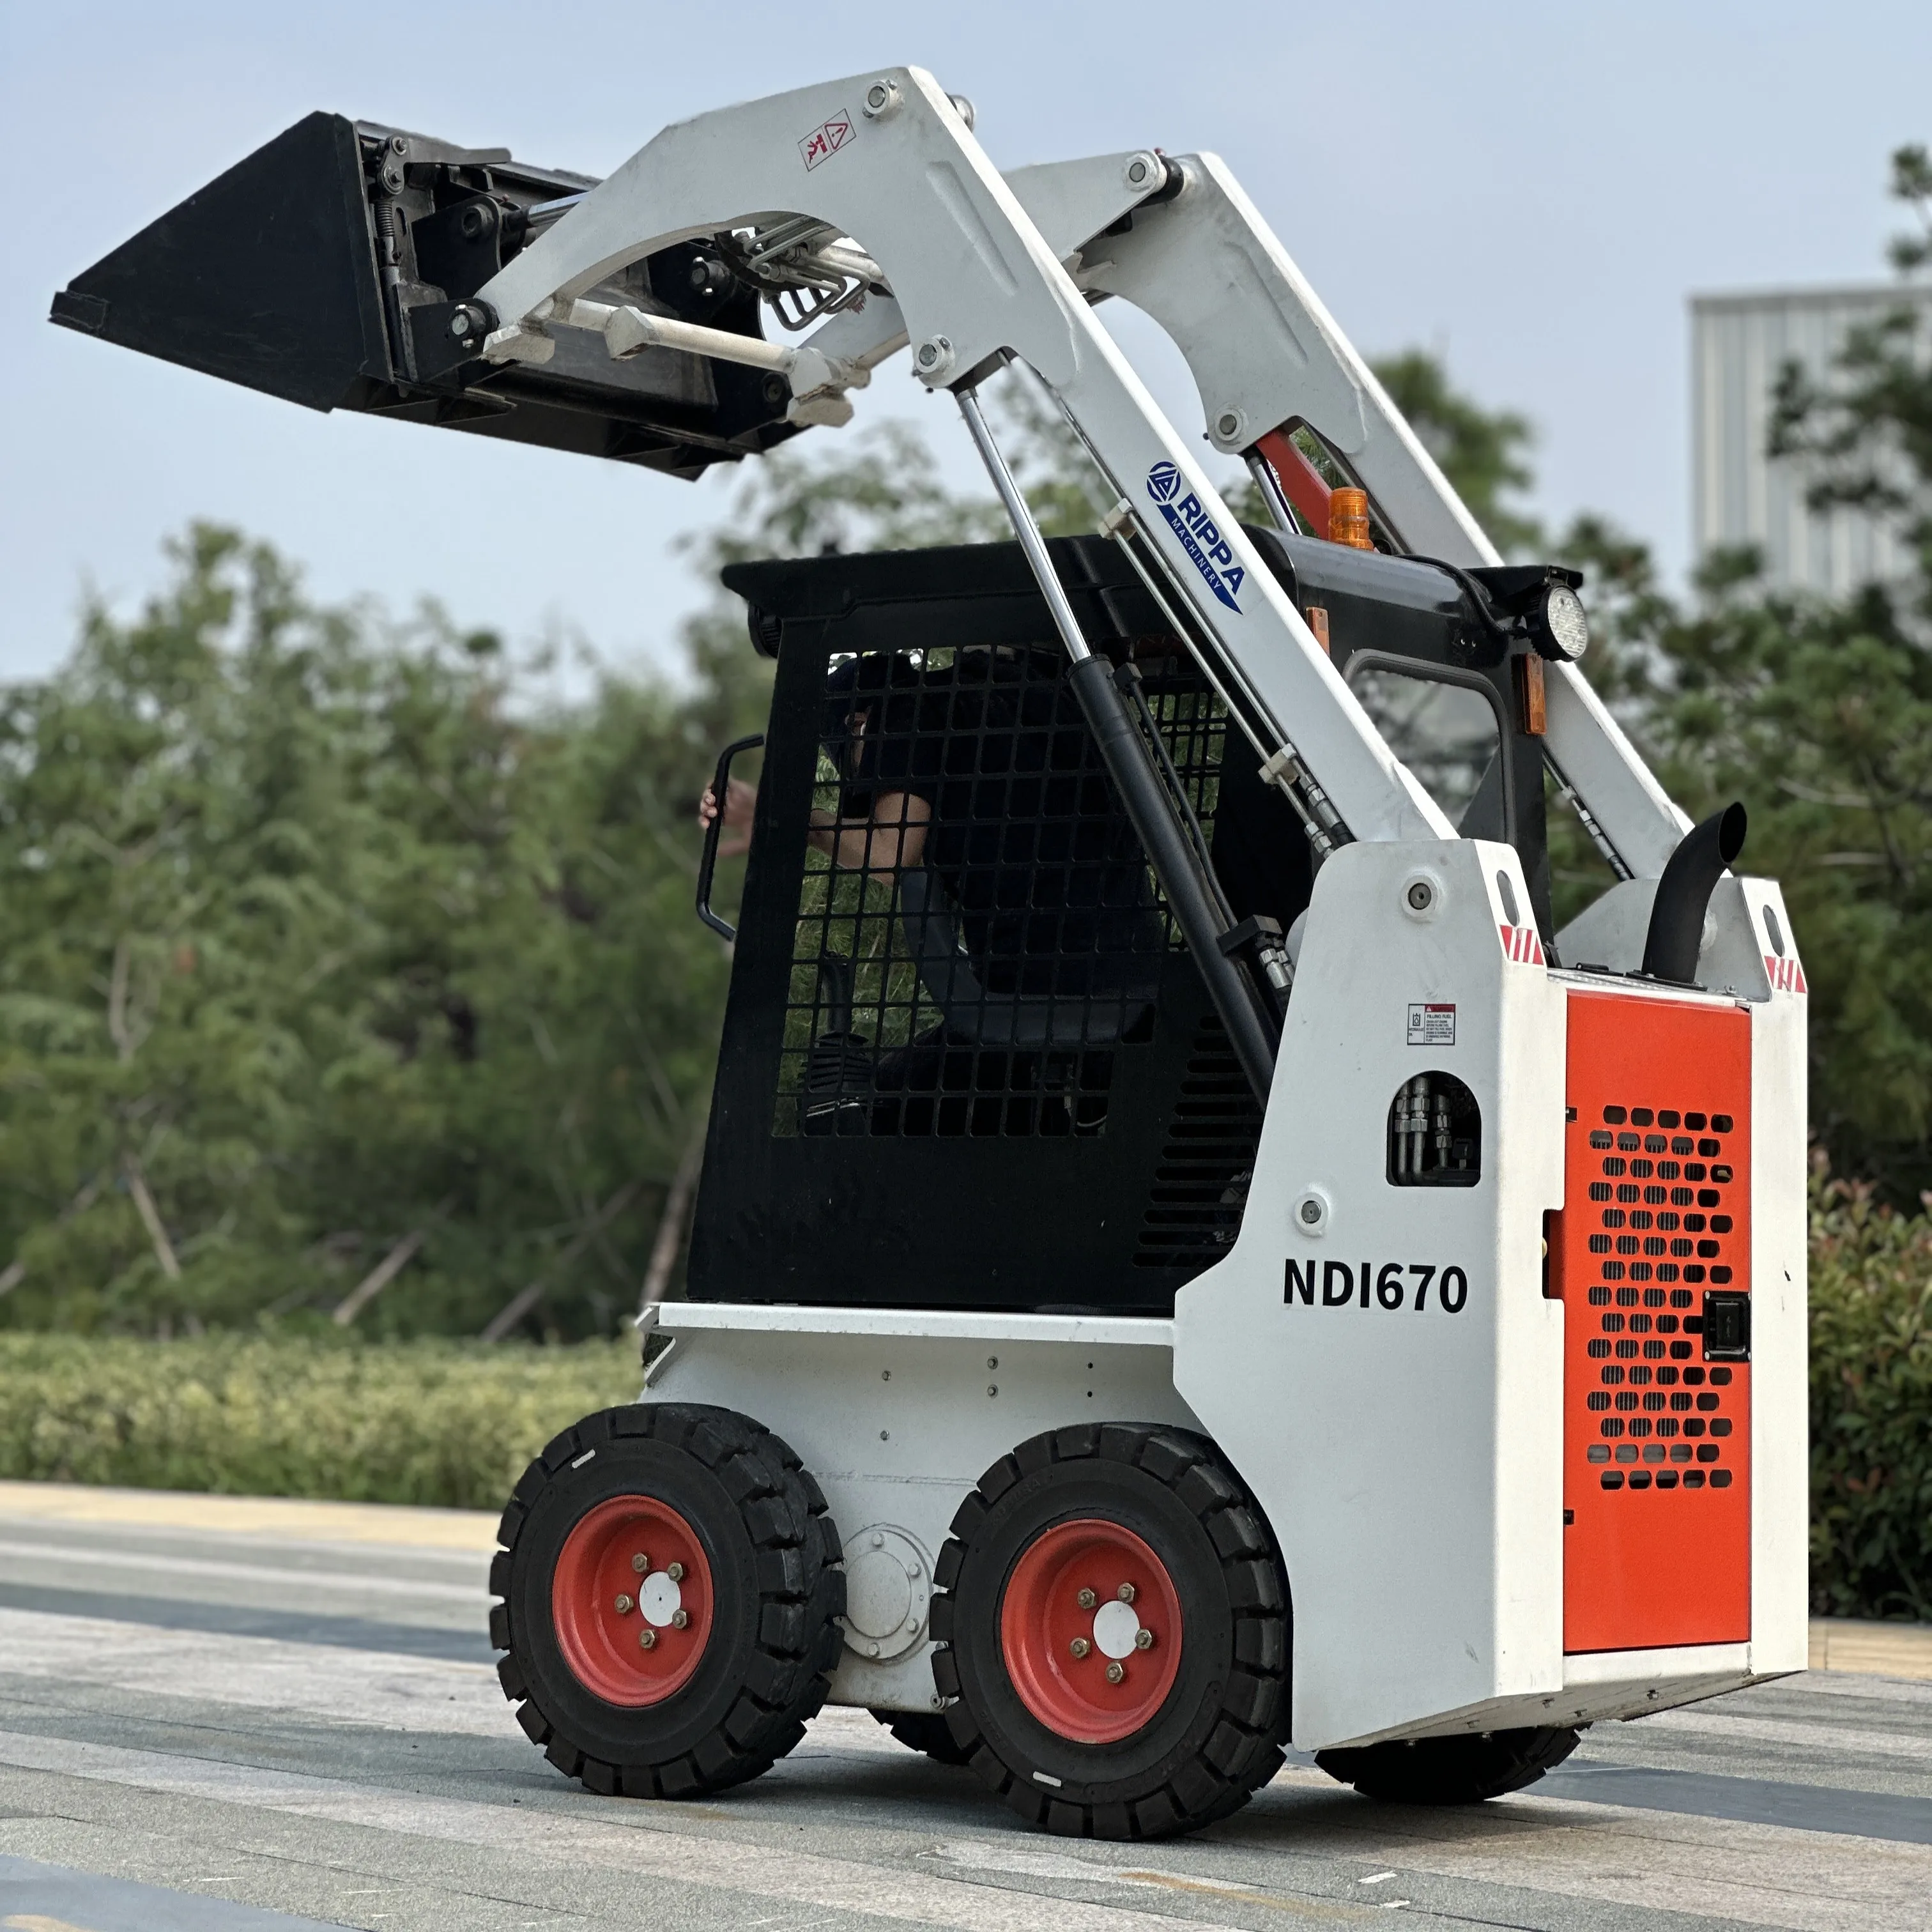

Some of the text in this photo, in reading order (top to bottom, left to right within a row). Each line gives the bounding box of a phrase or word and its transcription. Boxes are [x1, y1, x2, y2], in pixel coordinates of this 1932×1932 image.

[1171, 518, 1222, 589] MACHINERY
[1177, 492, 1245, 595] RIPPA
[1284, 1258, 1468, 1314] NDI670
